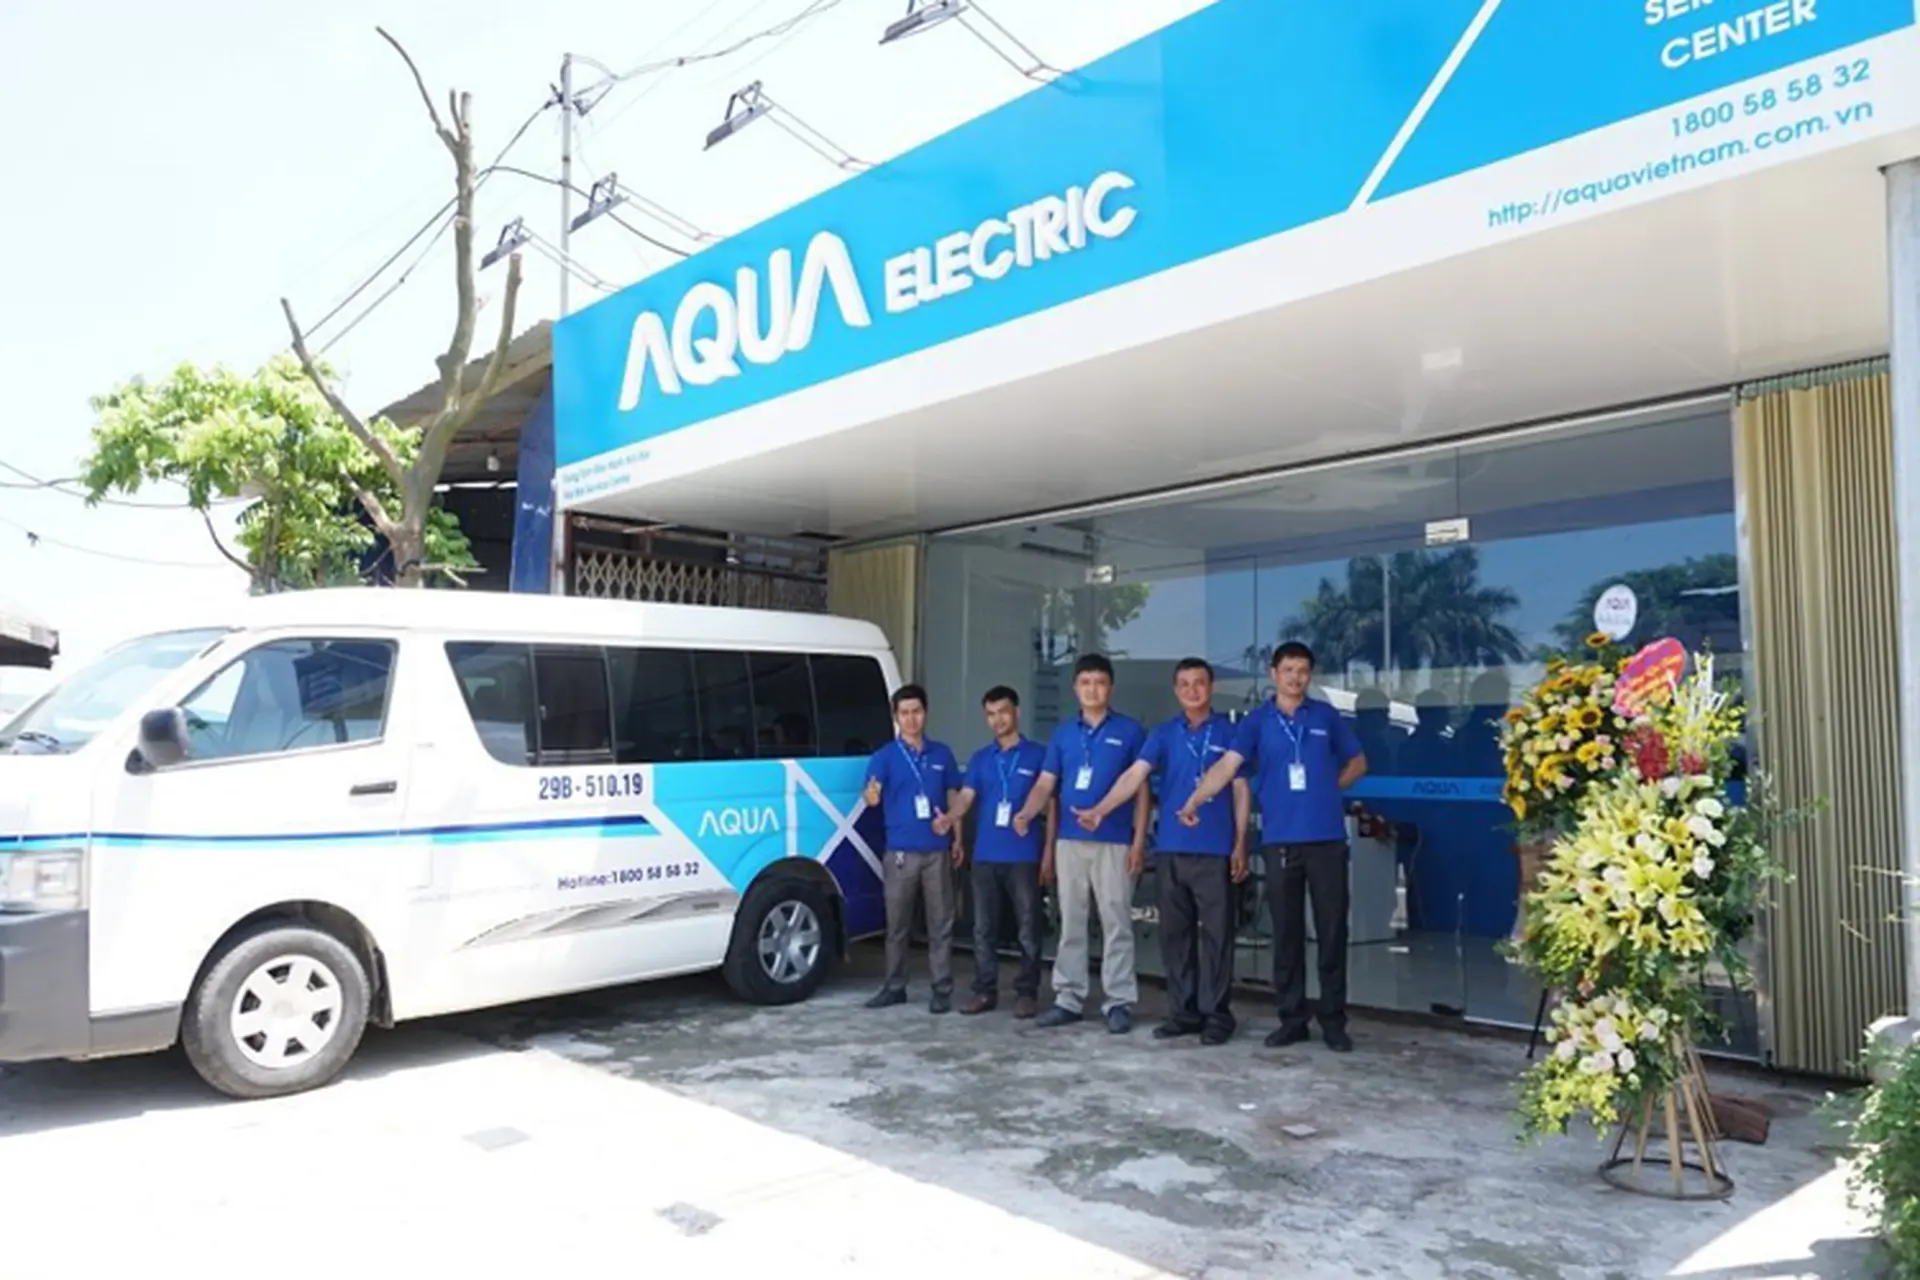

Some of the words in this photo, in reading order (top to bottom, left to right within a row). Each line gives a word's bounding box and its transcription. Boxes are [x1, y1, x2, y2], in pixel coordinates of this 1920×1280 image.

[1660, 0, 1818, 69] CENTER
[1671, 102, 1735, 138] 1800
[1742, 89, 1777, 116] 58
[1786, 74, 1823, 102] 58
[1833, 58, 1871, 88] 32
[618, 231, 872, 412] AQUA
[884, 171, 1138, 313] ELECTRIC
[1412, 780, 1460, 795] AQUA
[697, 807, 780, 837] AQUA
[647, 866, 662, 880] 58
[665, 863, 681, 878] 58
[684, 861, 700, 876] 32
